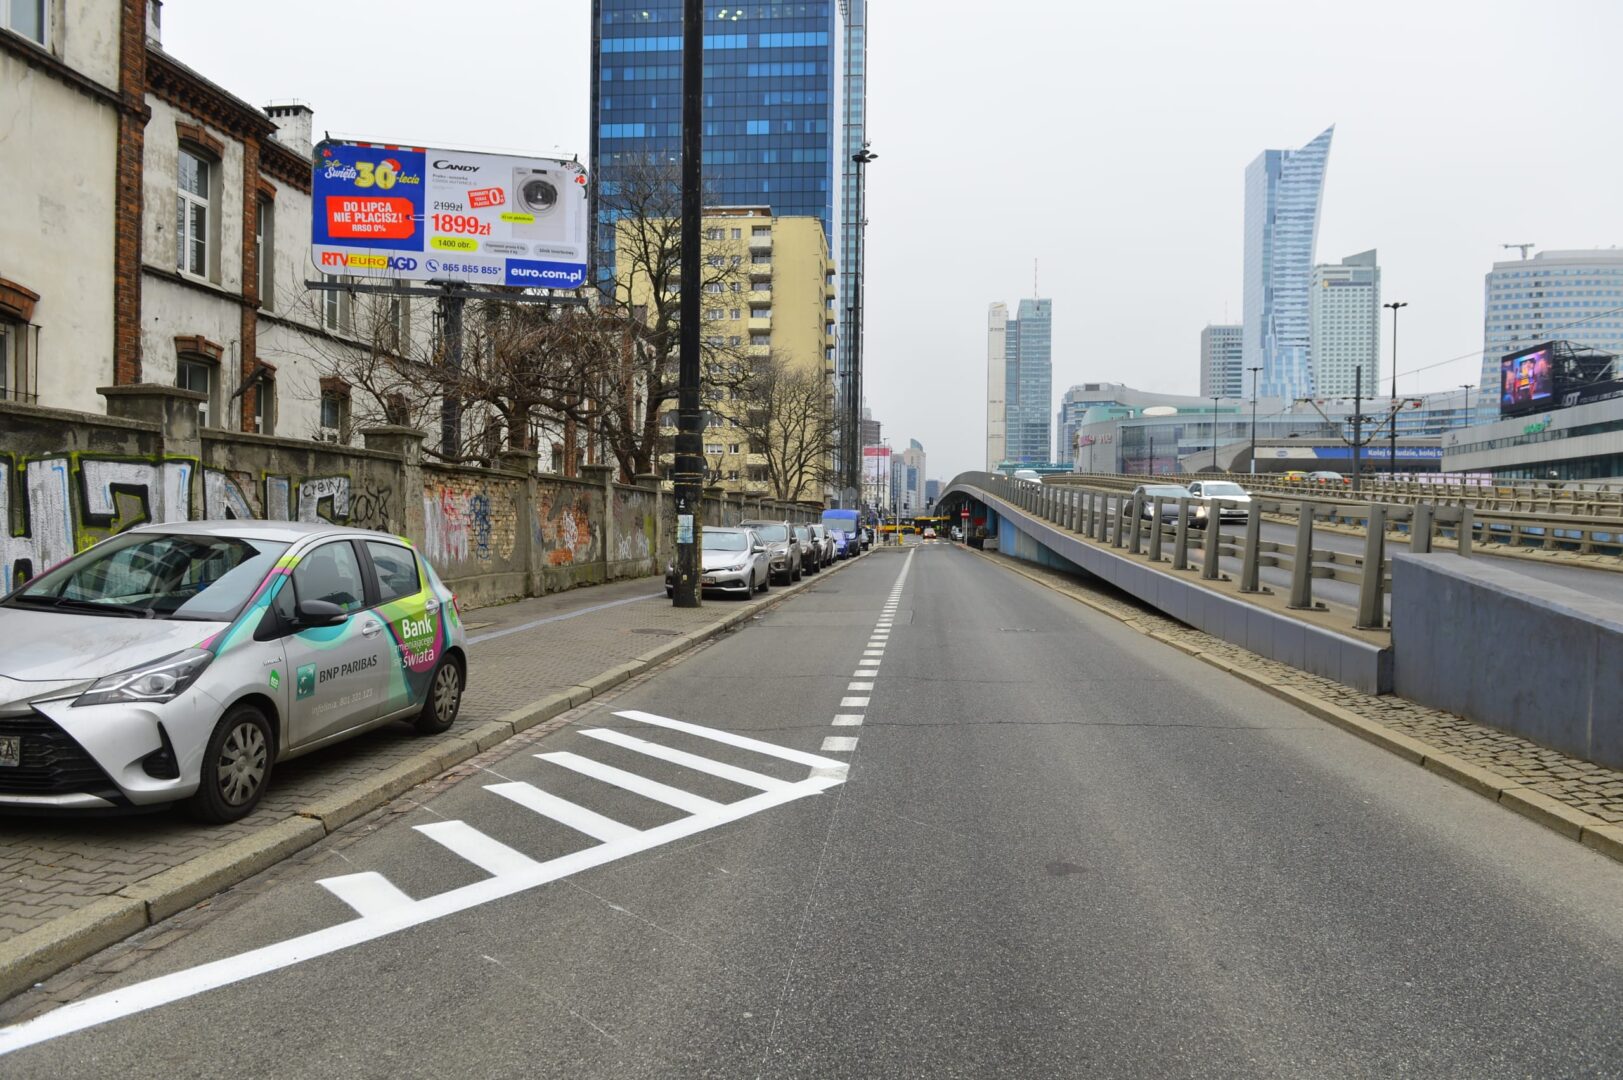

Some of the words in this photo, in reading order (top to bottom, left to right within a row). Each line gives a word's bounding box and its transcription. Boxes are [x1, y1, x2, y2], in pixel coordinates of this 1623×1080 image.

[433, 160, 480, 173] CANDY
[343, 201, 358, 211] DO
[361, 201, 392, 212] LIPCA
[434, 200, 463, 212] 2199zł
[334, 212, 352, 223] NIE
[355, 212, 403, 223] PŁACISZ!
[352, 224, 372, 232] RRSO
[432, 213, 491, 236] 1899zł
[438, 239, 456, 248] 1400
[457, 240, 471, 249] obr.
[321, 252, 348, 267] RTV
[387, 257, 418, 271] AGD
[462, 264, 478, 273] 855
[510, 268, 582, 282] euro.com.pl
[402, 615, 433, 639] Bank
[402, 649, 434, 668] świata
[318, 667, 339, 684] BNP
[341, 654, 378, 677] PARIBAS
